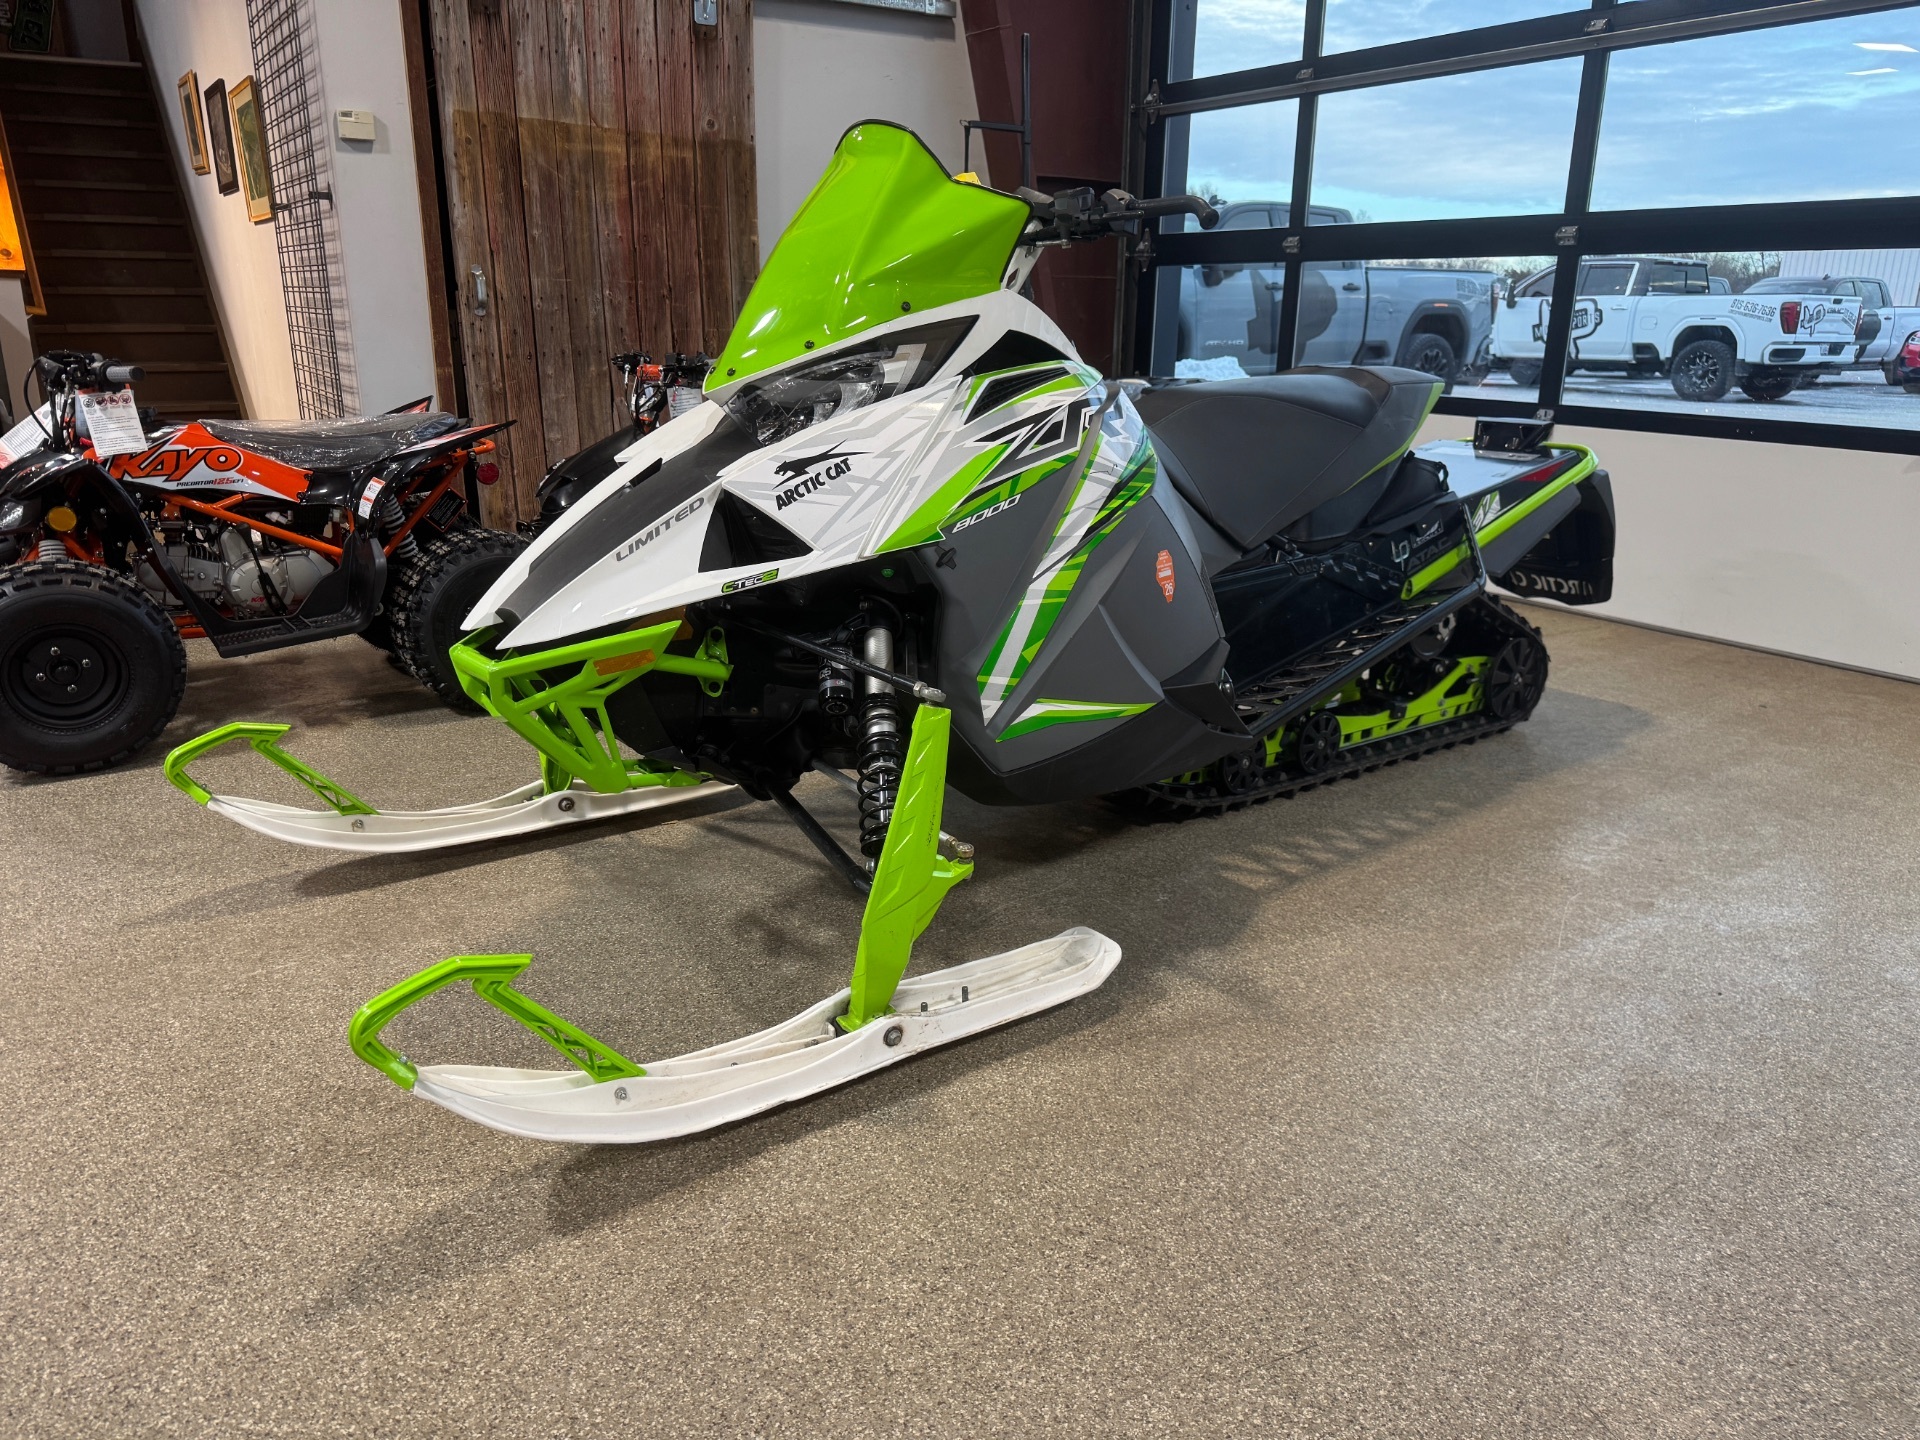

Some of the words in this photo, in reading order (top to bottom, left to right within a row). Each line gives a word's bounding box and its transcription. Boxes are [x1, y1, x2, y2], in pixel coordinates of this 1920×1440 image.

[108, 434, 241, 482] KAYO
[775, 471, 826, 511] ARCTIC
[825, 457, 852, 480] CAT
[616, 497, 705, 562] LIMITED
[952, 493, 1022, 533] 8000
[1165, 583, 1174, 596] 26
